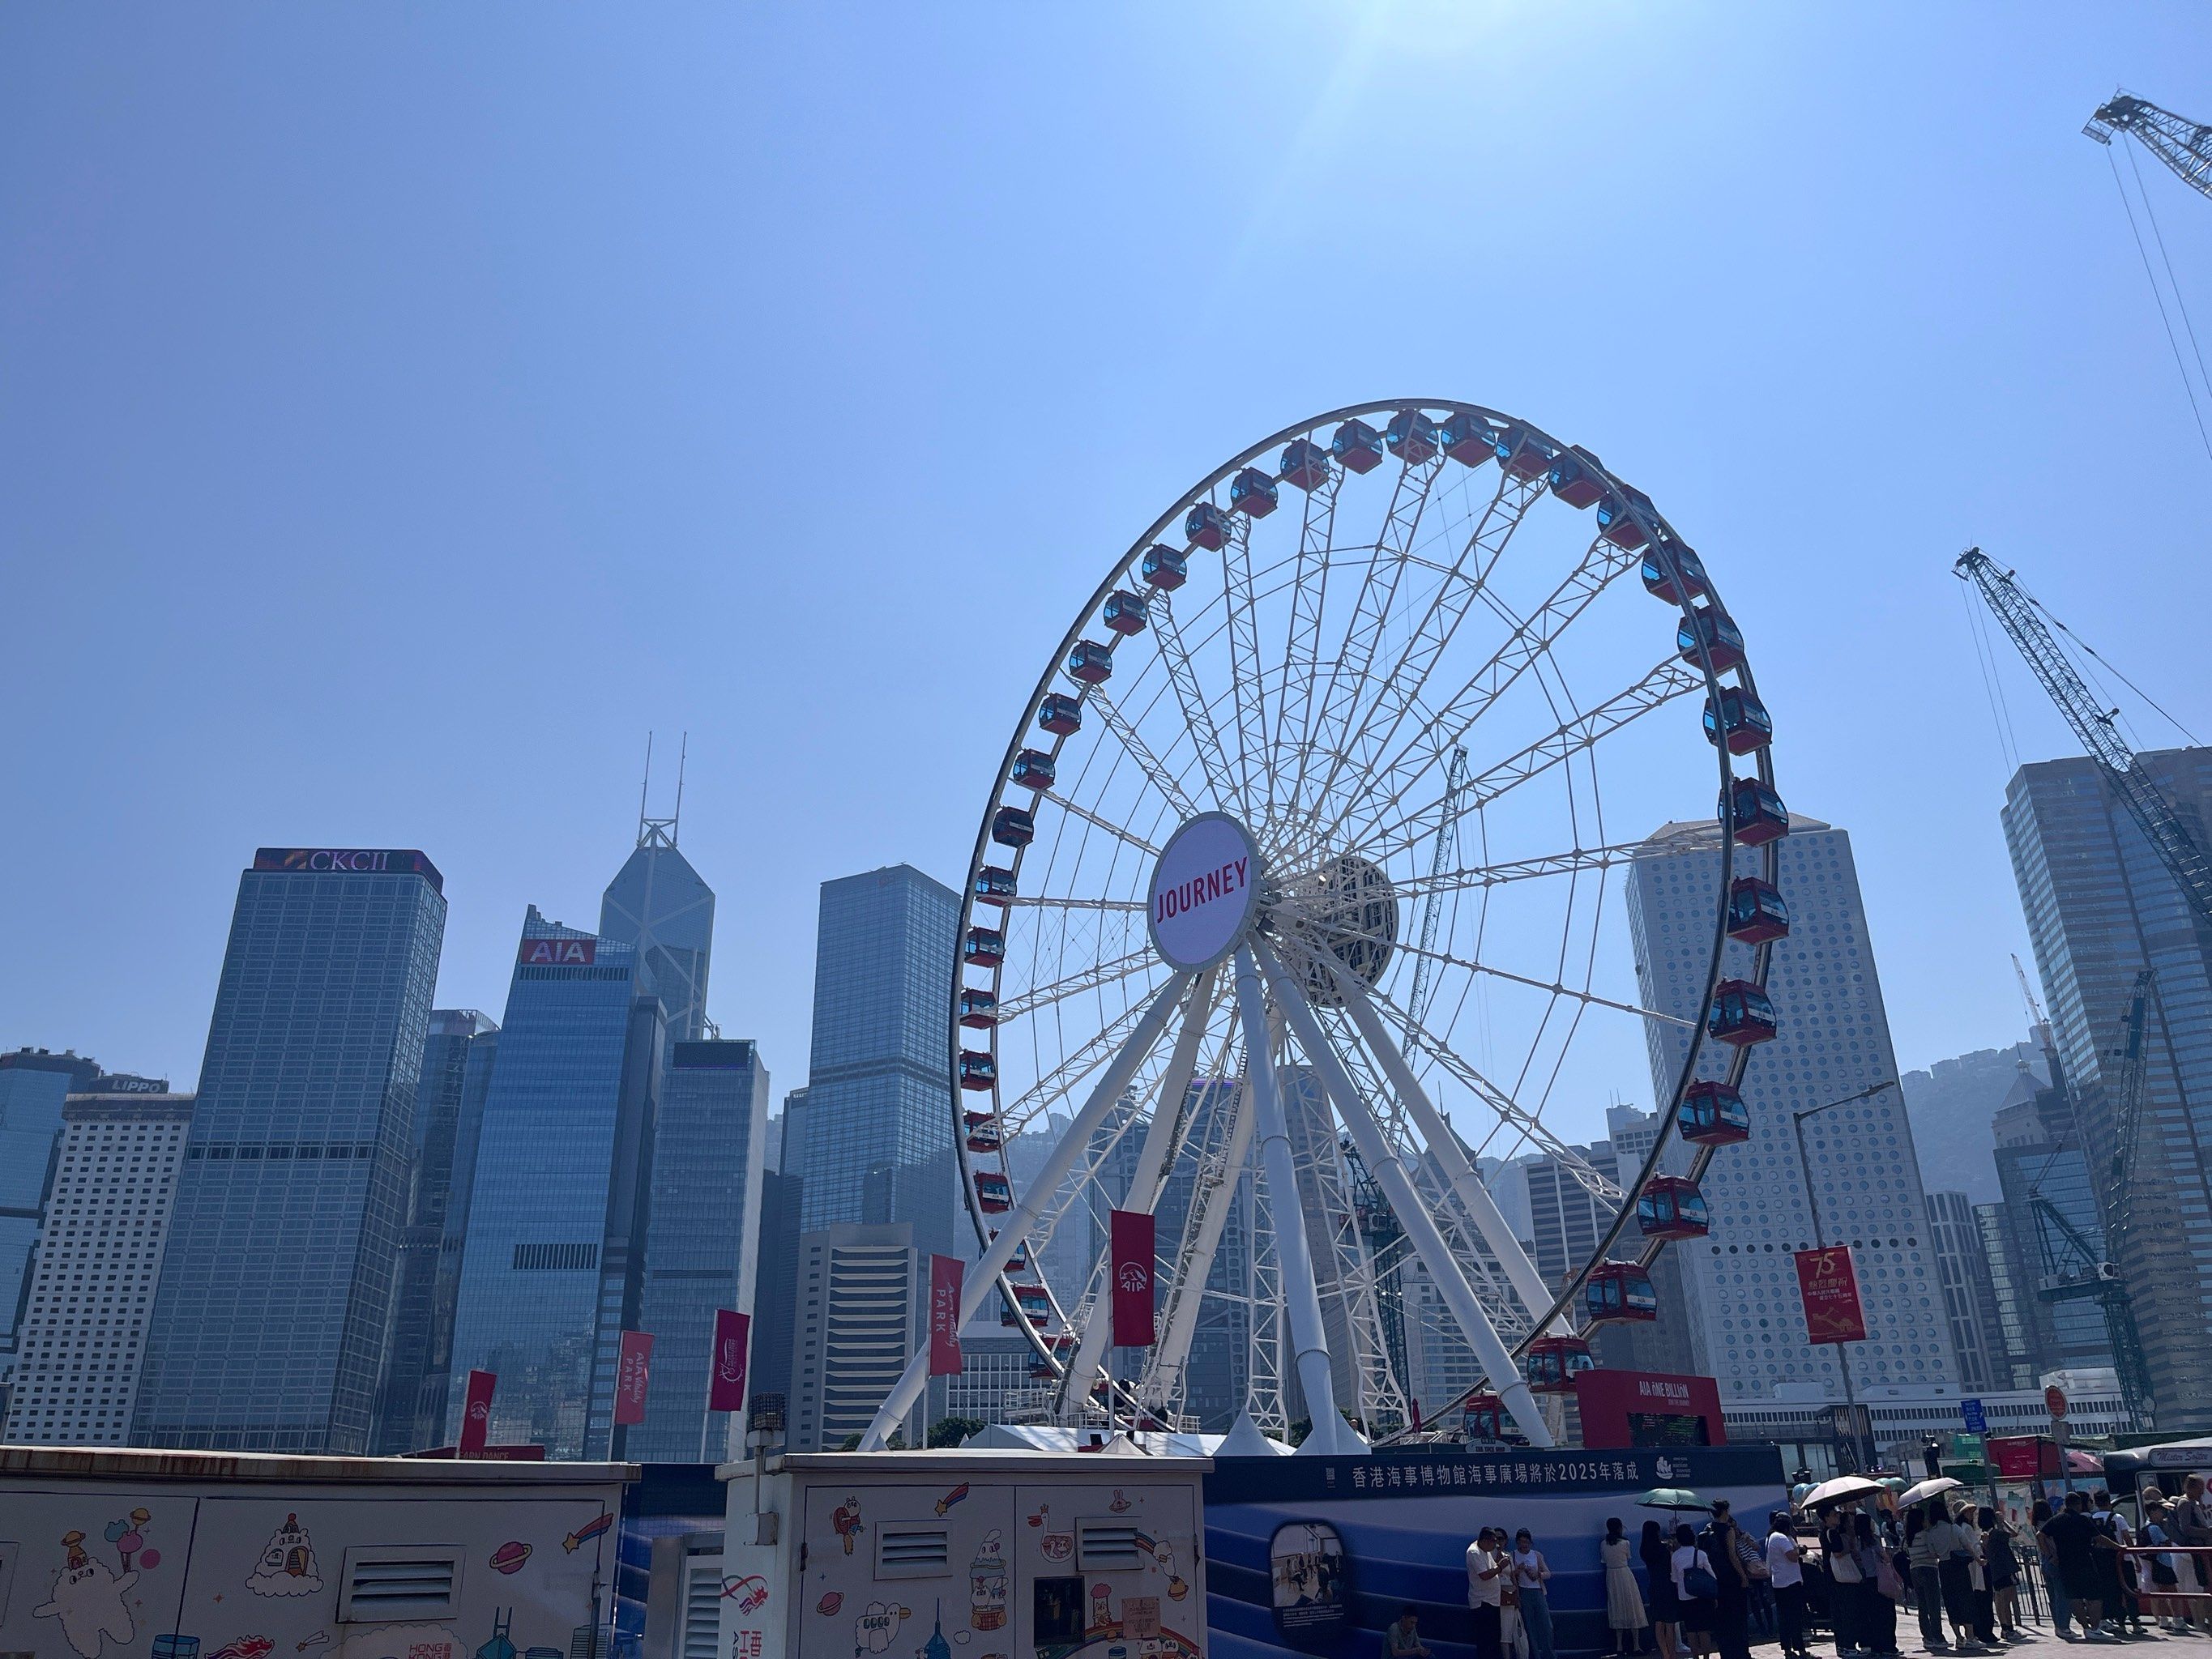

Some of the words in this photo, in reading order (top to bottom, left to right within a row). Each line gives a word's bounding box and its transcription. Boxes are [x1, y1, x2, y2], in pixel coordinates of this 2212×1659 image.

[1157, 856, 1247, 923] JOURNEY
[529, 941, 586, 962] AIA
[112, 1079, 160, 1093] LIPPO
[1809, 1252, 1835, 1278] 75
[1121, 1281, 1146, 1292] AIA
[936, 1289, 946, 1332] PARK
[635, 1352, 644, 1375] AIA
[623, 1358, 634, 1392] PARK
[630, 1376, 644, 1404] Vitality
[1639, 1380, 1652, 1396] AIA
[471, 1412, 485, 1420] AIA
[2157, 1452, 2183, 1461] Mister
[1352, 1461, 1638, 1488] 香港海事博物館海事廣場將於2025年落成
[409, 1643, 443, 1653] HONG
